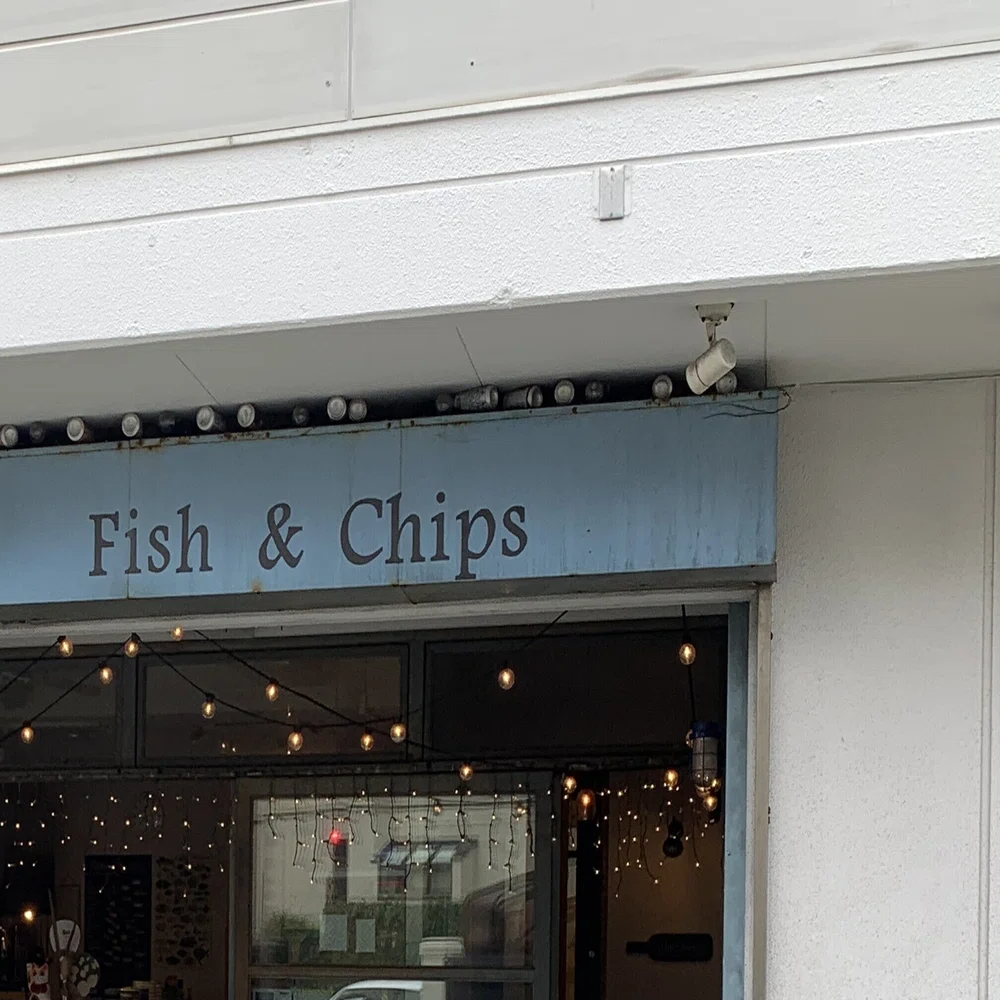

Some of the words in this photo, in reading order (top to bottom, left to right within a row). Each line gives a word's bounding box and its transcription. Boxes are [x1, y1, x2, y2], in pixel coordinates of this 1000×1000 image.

[88, 503, 213, 577] Fish
[258, 502, 305, 571] &
[339, 491, 529, 580] Chips
